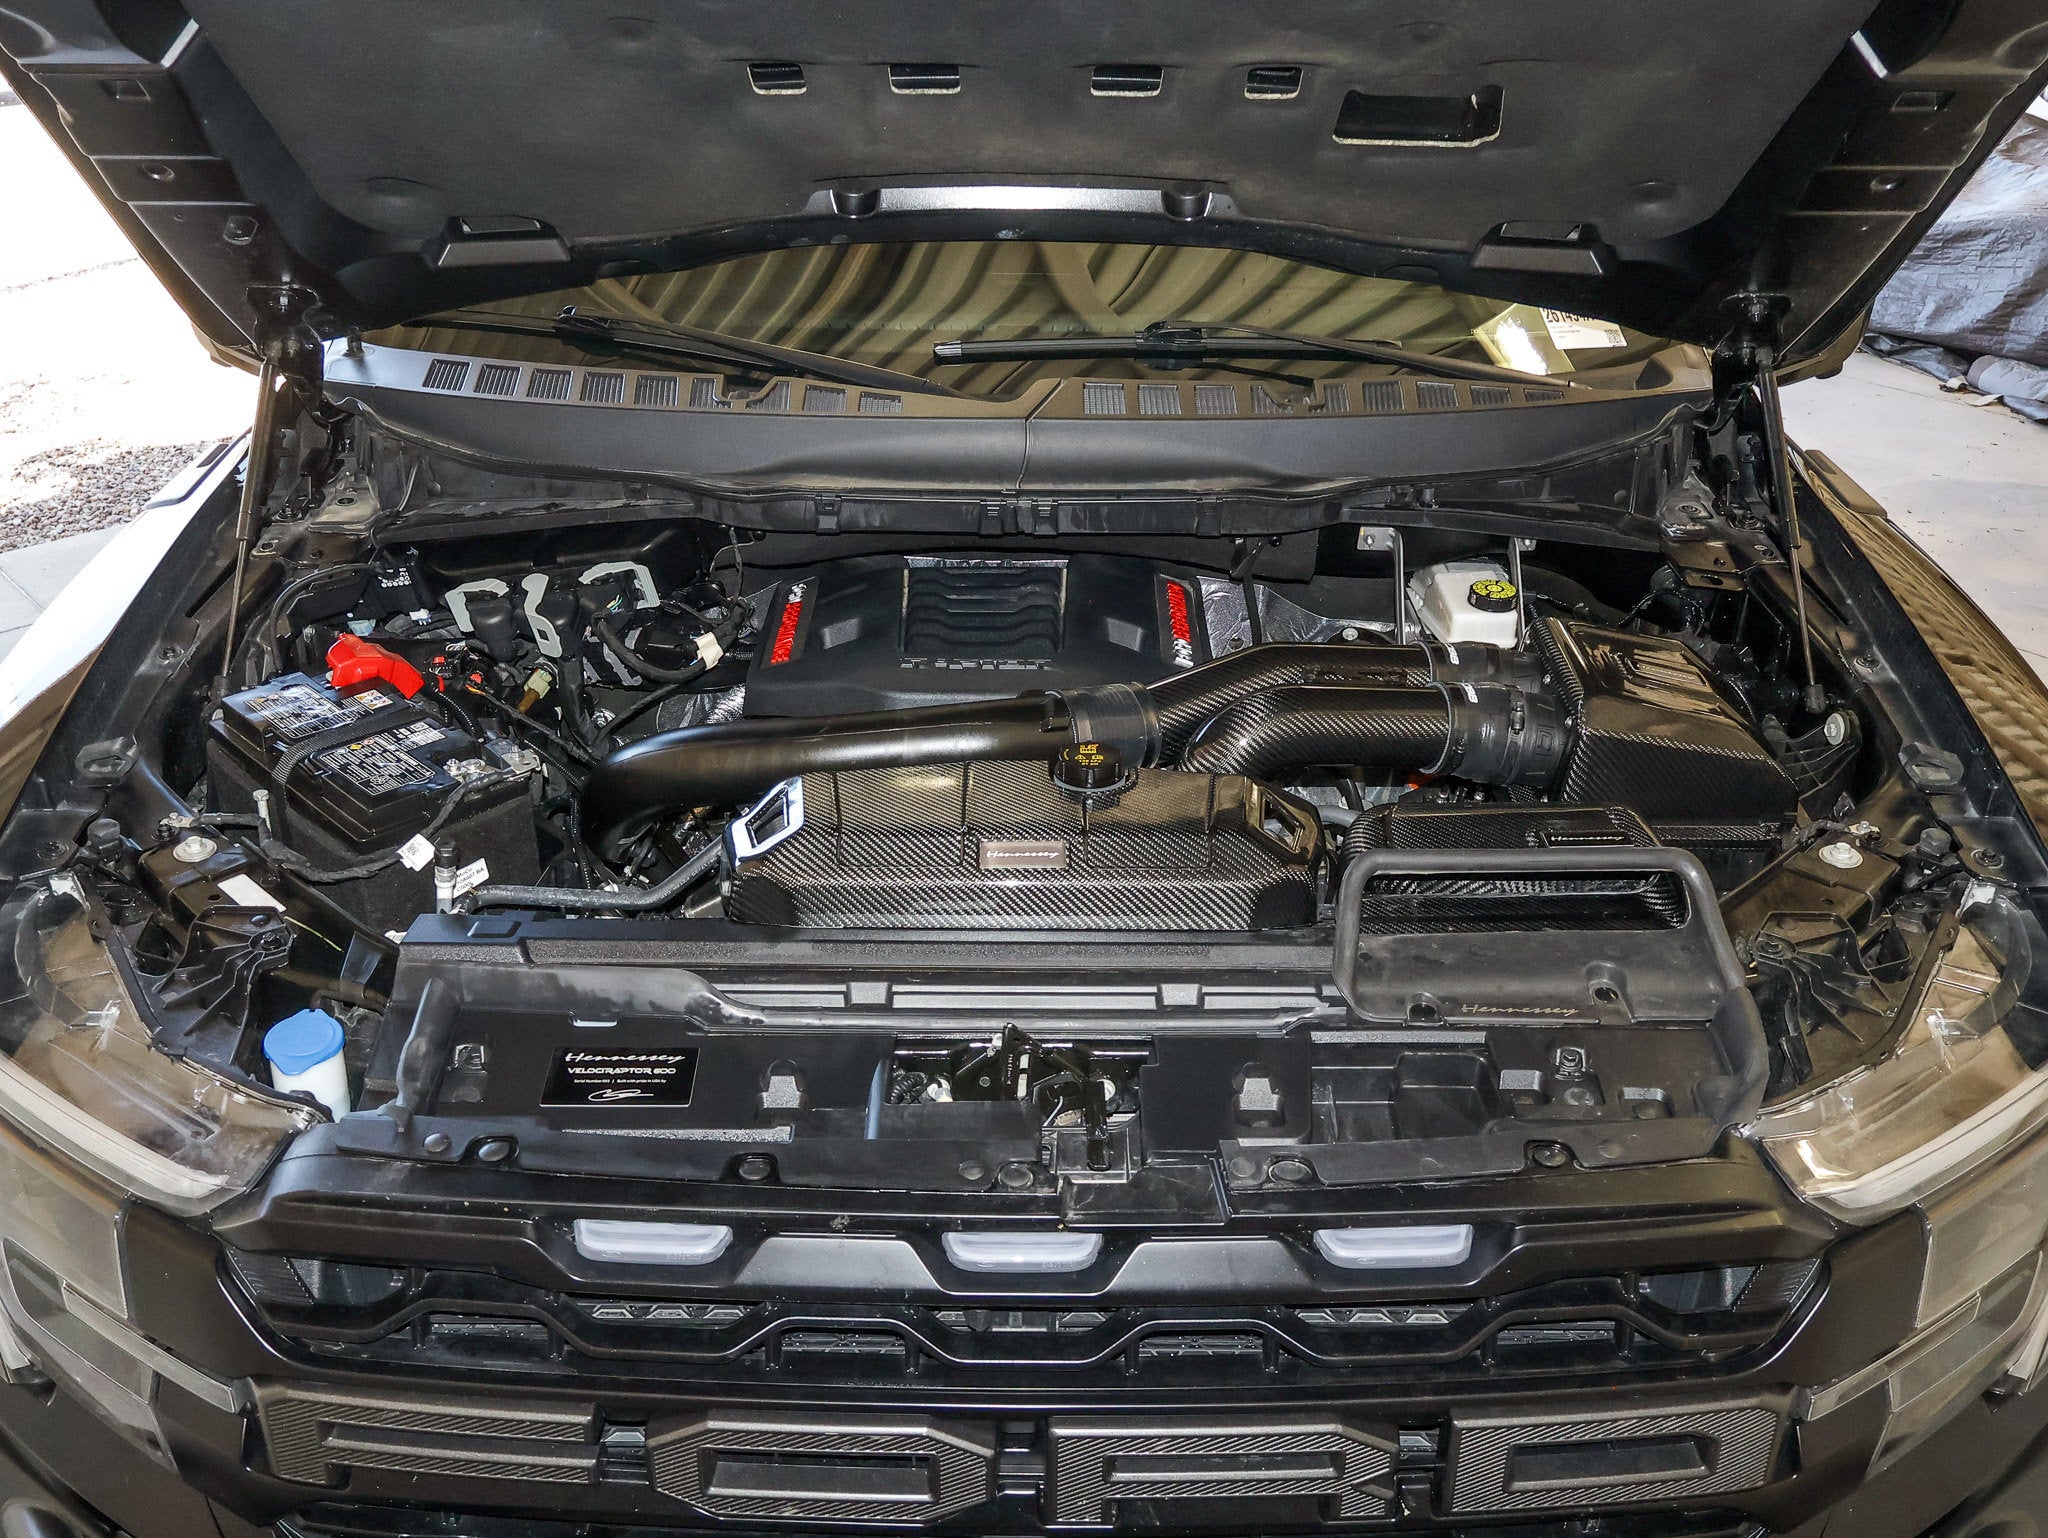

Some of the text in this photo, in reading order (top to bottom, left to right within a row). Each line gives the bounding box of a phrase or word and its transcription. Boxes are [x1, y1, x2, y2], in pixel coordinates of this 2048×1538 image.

[986, 850, 1061, 859] Hennessey
[1461, 1003, 1579, 1017] Hennessey
[564, 1052, 686, 1064] Hennessey
[567, 1067, 677, 1075] VELOCIRAPTOR 600
[254, 1380, 1782, 1528] FORD
